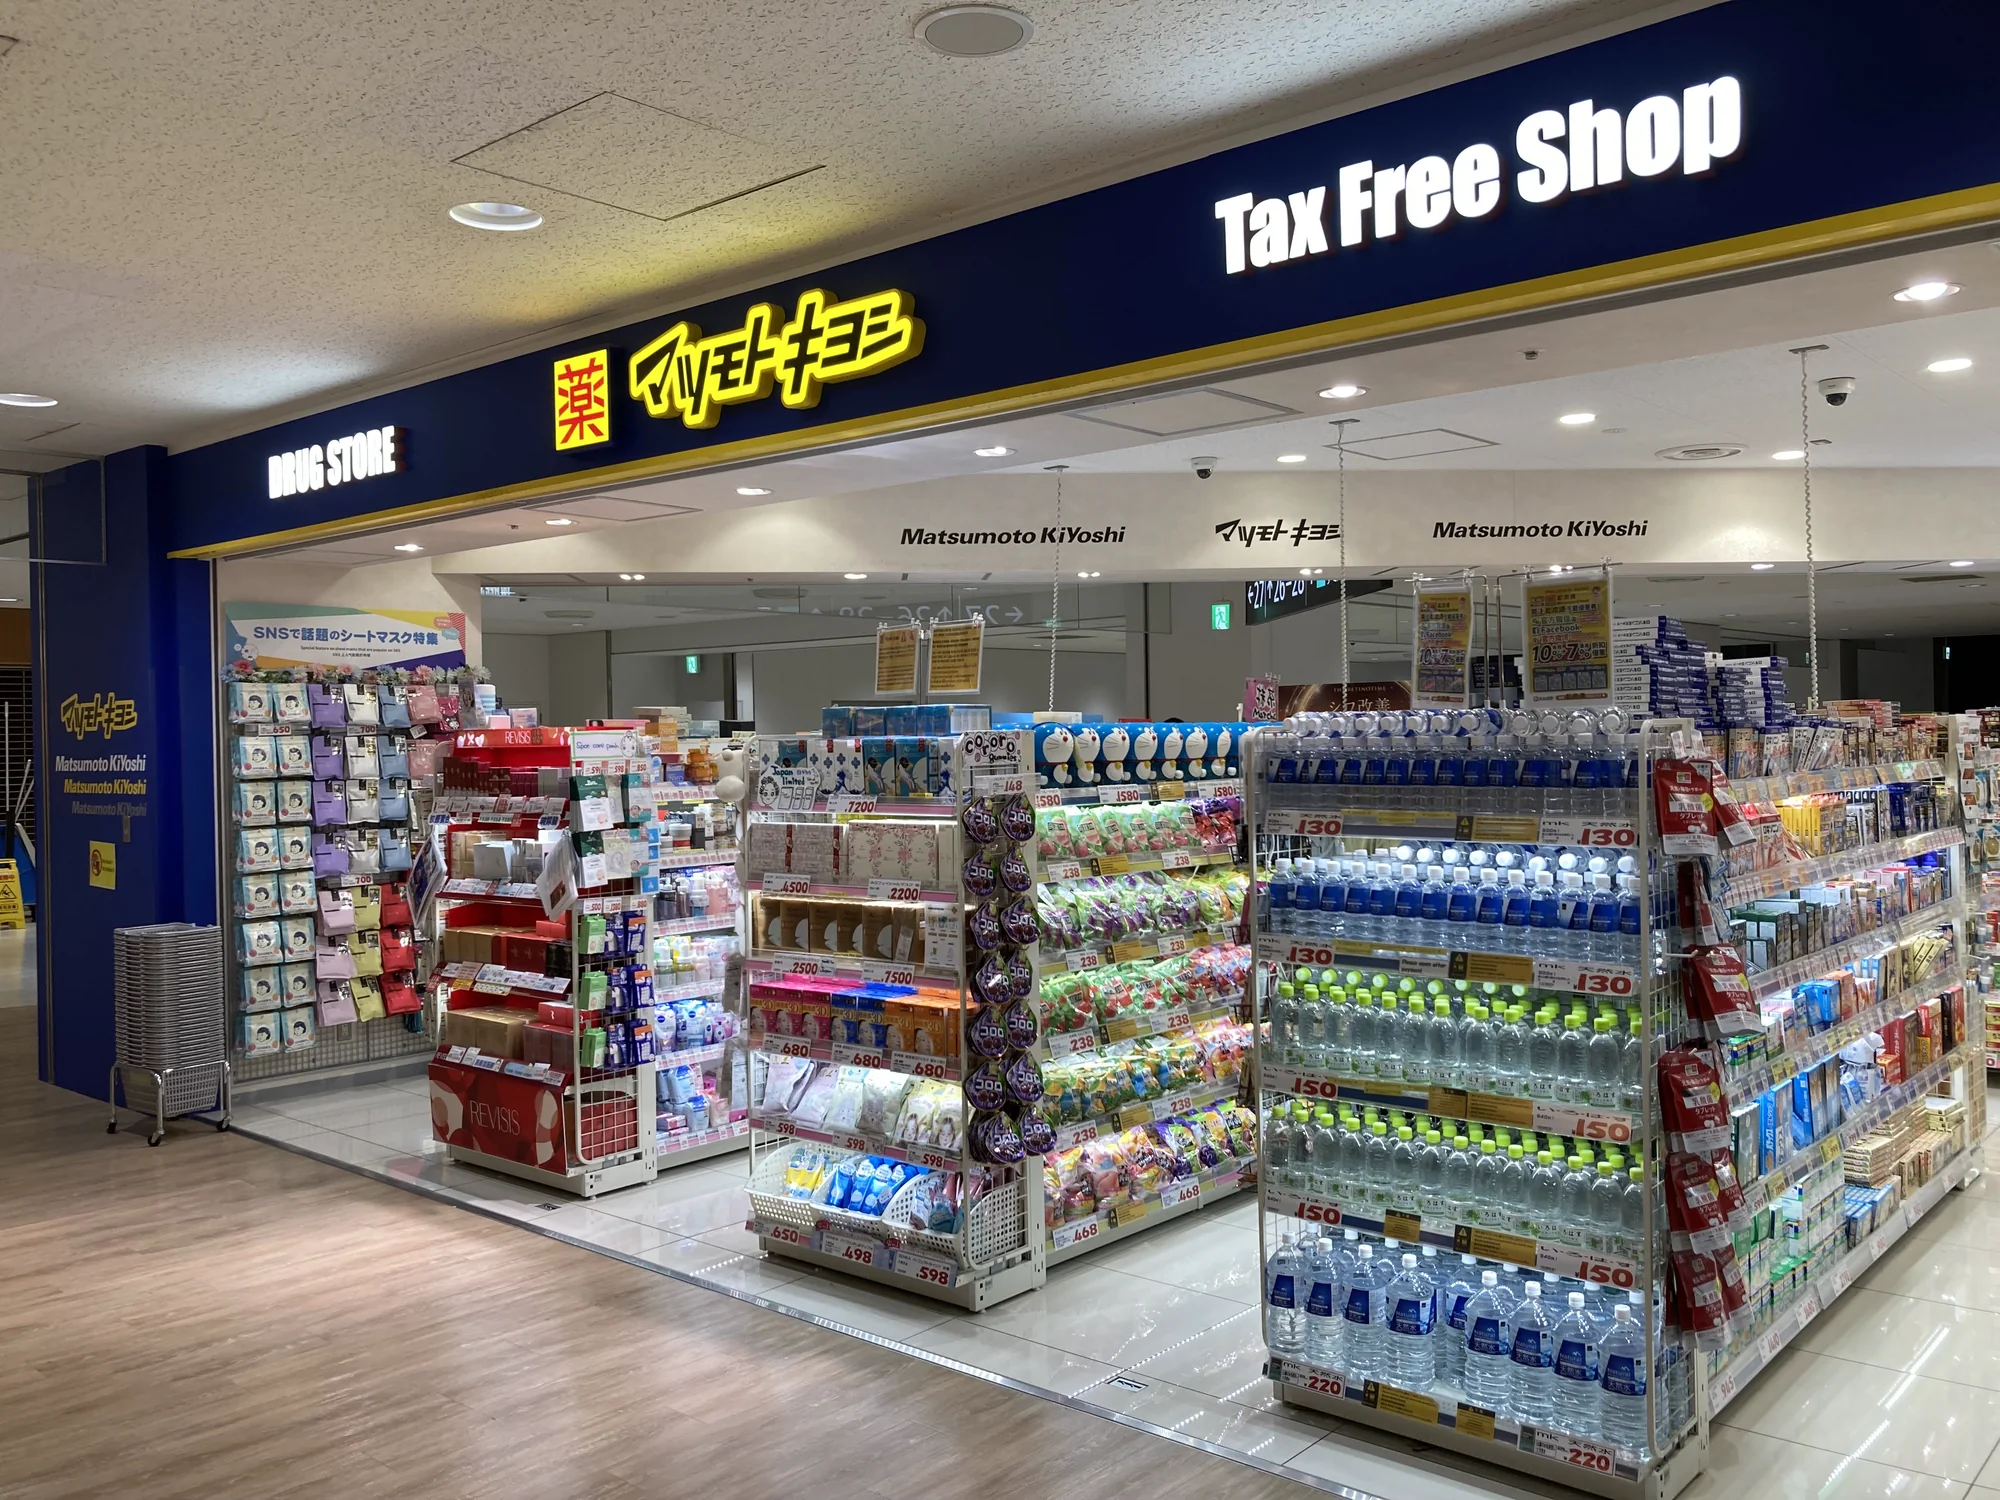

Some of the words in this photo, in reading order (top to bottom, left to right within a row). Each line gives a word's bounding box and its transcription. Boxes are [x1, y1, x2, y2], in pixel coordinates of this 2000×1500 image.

[1214, 185, 1329, 275] Tax
[1338, 143, 1501, 248] Free
[1516, 75, 1742, 204] Shop
[629, 289, 913, 427] マツモトキヨシ
[556, 358, 606, 445] 薬
[268, 444, 326, 499] DRUG
[326, 425, 398, 487] STORE
[900, 528, 1036, 546] Matsumoto
[1040, 526, 1126, 544] KiYoshi
[1214, 518, 1342, 547] マツモトキヨシ
[1432, 521, 1563, 539] Matsumoto
[1566, 520, 1648, 537] KiYoshi
[1253, 581, 1265, 609] 27
[253, 626, 439, 646] SNSで話題のシートマスク特集
[1540, 624, 1581, 633] Facebook
[61, 692, 138, 740] マツモトキヨシ
[273, 726, 290, 734] 650
[360, 726, 376, 734] 700
[55, 755, 109, 772] Matsumoto
[109, 754, 147, 772] KiYoshi
[64, 779, 113, 795] Matsumoto
[113, 778, 147, 795] KiYoshi
[71, 801, 116, 816] Matsumoto
[116, 801, 147, 817] KiYoshi
[355, 876, 372, 884] 700
[783, 881, 809, 893] 4500
[890, 888, 919, 900] 2200
[791, 962, 819, 975] 2500
[885, 970, 912, 984] 7500
[1168, 1015, 1190, 1028] 238
[783, 1042, 809, 1058] 680
[1071, 1036, 1094, 1050] 238
[853, 1053, 881, 1068] 680
[914, 1063, 944, 1078] 680
[1170, 1097, 1192, 1112] 238
[470, 1100, 521, 1136] REVISIS
[776, 1123, 795, 1135] 598
[1073, 1127, 1097, 1145] 238
[847, 1138, 865, 1151] 598
[923, 1153, 943, 1167] 598
[1179, 1184, 1200, 1202] 468
[772, 1226, 798, 1243] 650
[1073, 1223, 1098, 1242] 468
[844, 1246, 872, 1264] 498
[919, 1266, 949, 1286] 598
[1395, 1310, 1417, 1319] Natural
[1395, 1322, 1417, 1332] 天然水
[1474, 1329, 1496, 1338] Natural
[1474, 1341, 1496, 1351] 天然水
[1516, 1341, 1537, 1350] Natural
[1515, 1352, 1537, 1363] 天然水
[1559, 1353, 1582, 1363] Natural
[1560, 1365, 1582, 1377] 天然水
[1607, 1367, 1631, 1377] Natural
[1607, 1380, 1632, 1391] 天然水
